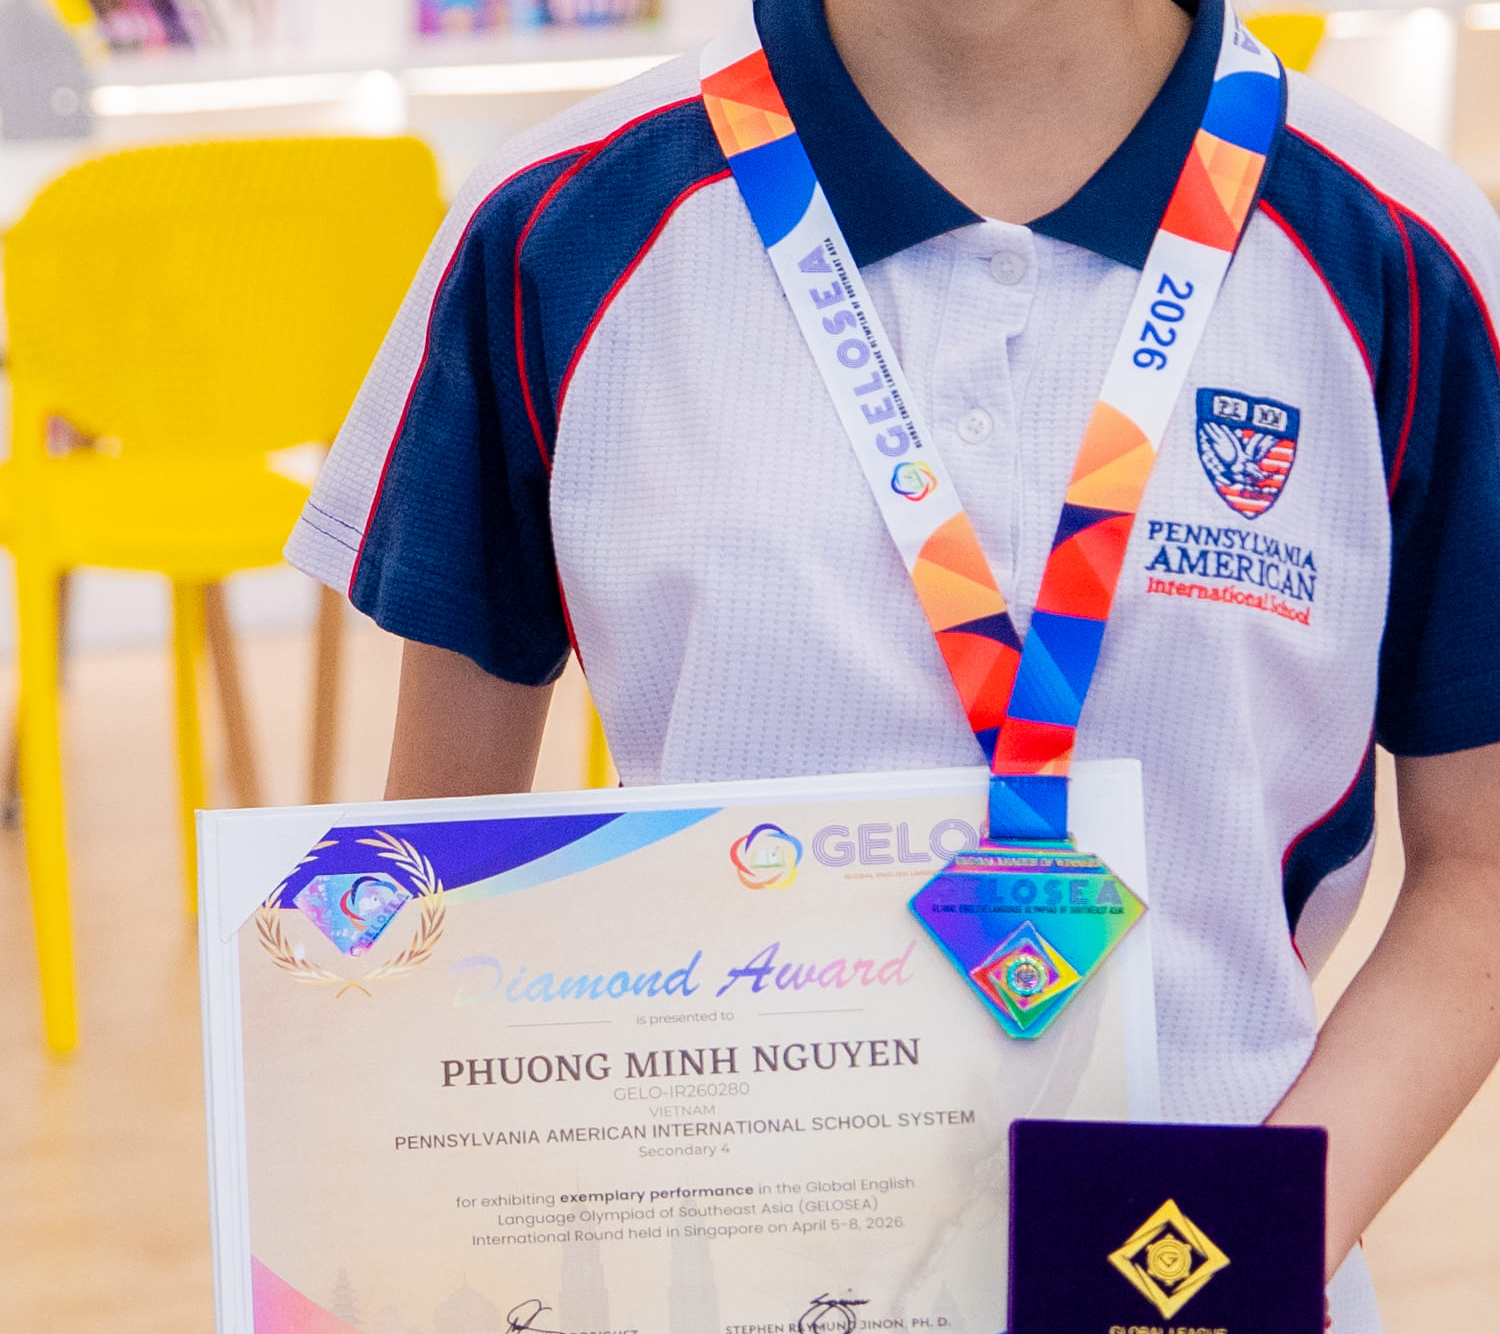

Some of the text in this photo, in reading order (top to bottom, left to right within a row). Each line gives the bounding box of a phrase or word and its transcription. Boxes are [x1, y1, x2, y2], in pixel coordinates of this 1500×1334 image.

[1132, 272, 1194, 371] 2026
[798, 244, 910, 457] GELOSEA
[1148, 520, 1317, 572] PENNSYLVANIA
[1145, 545, 1317, 602] AMERICAN
[1146, 576, 1268, 611] International
[812, 818, 986, 867] GELO
[448, 939, 917, 1009] Diamond Award
[636, 1011, 734, 1027] is presented to
[441, 1038, 921, 1088] PHUONG MINH NGUYEN
[613, 1082, 750, 1101] GELO-IR260280
[648, 1105, 716, 1118] VIETNAM
[395, 1110, 976, 1150] PENNSYLVANIA AMERICAN INTERNATIONAL SCHOOL SYSTEM
[638, 1143, 730, 1159] Secondary 4
[456, 1177, 915, 1208] for exhibiting exemplary performance in the Global English
[498, 1196, 878, 1228] Language Olympiad of Southeast Asia (GELOSEA)
[472, 1230, 571, 1246] International
[575, 1227, 624, 1242] Round
[628, 1225, 662, 1240] held
[666, 1225, 680, 1238] in
[684, 1221, 764, 1240] Singapore
[767, 1223, 788, 1234] on
[792, 1219, 827, 1235] April
[725, 1322, 785, 1334] STEPHEN
[859, 1317, 908, 1331] JINON,
[911, 1317, 935, 1328] PH.
[937, 1316, 952, 1327] D.
